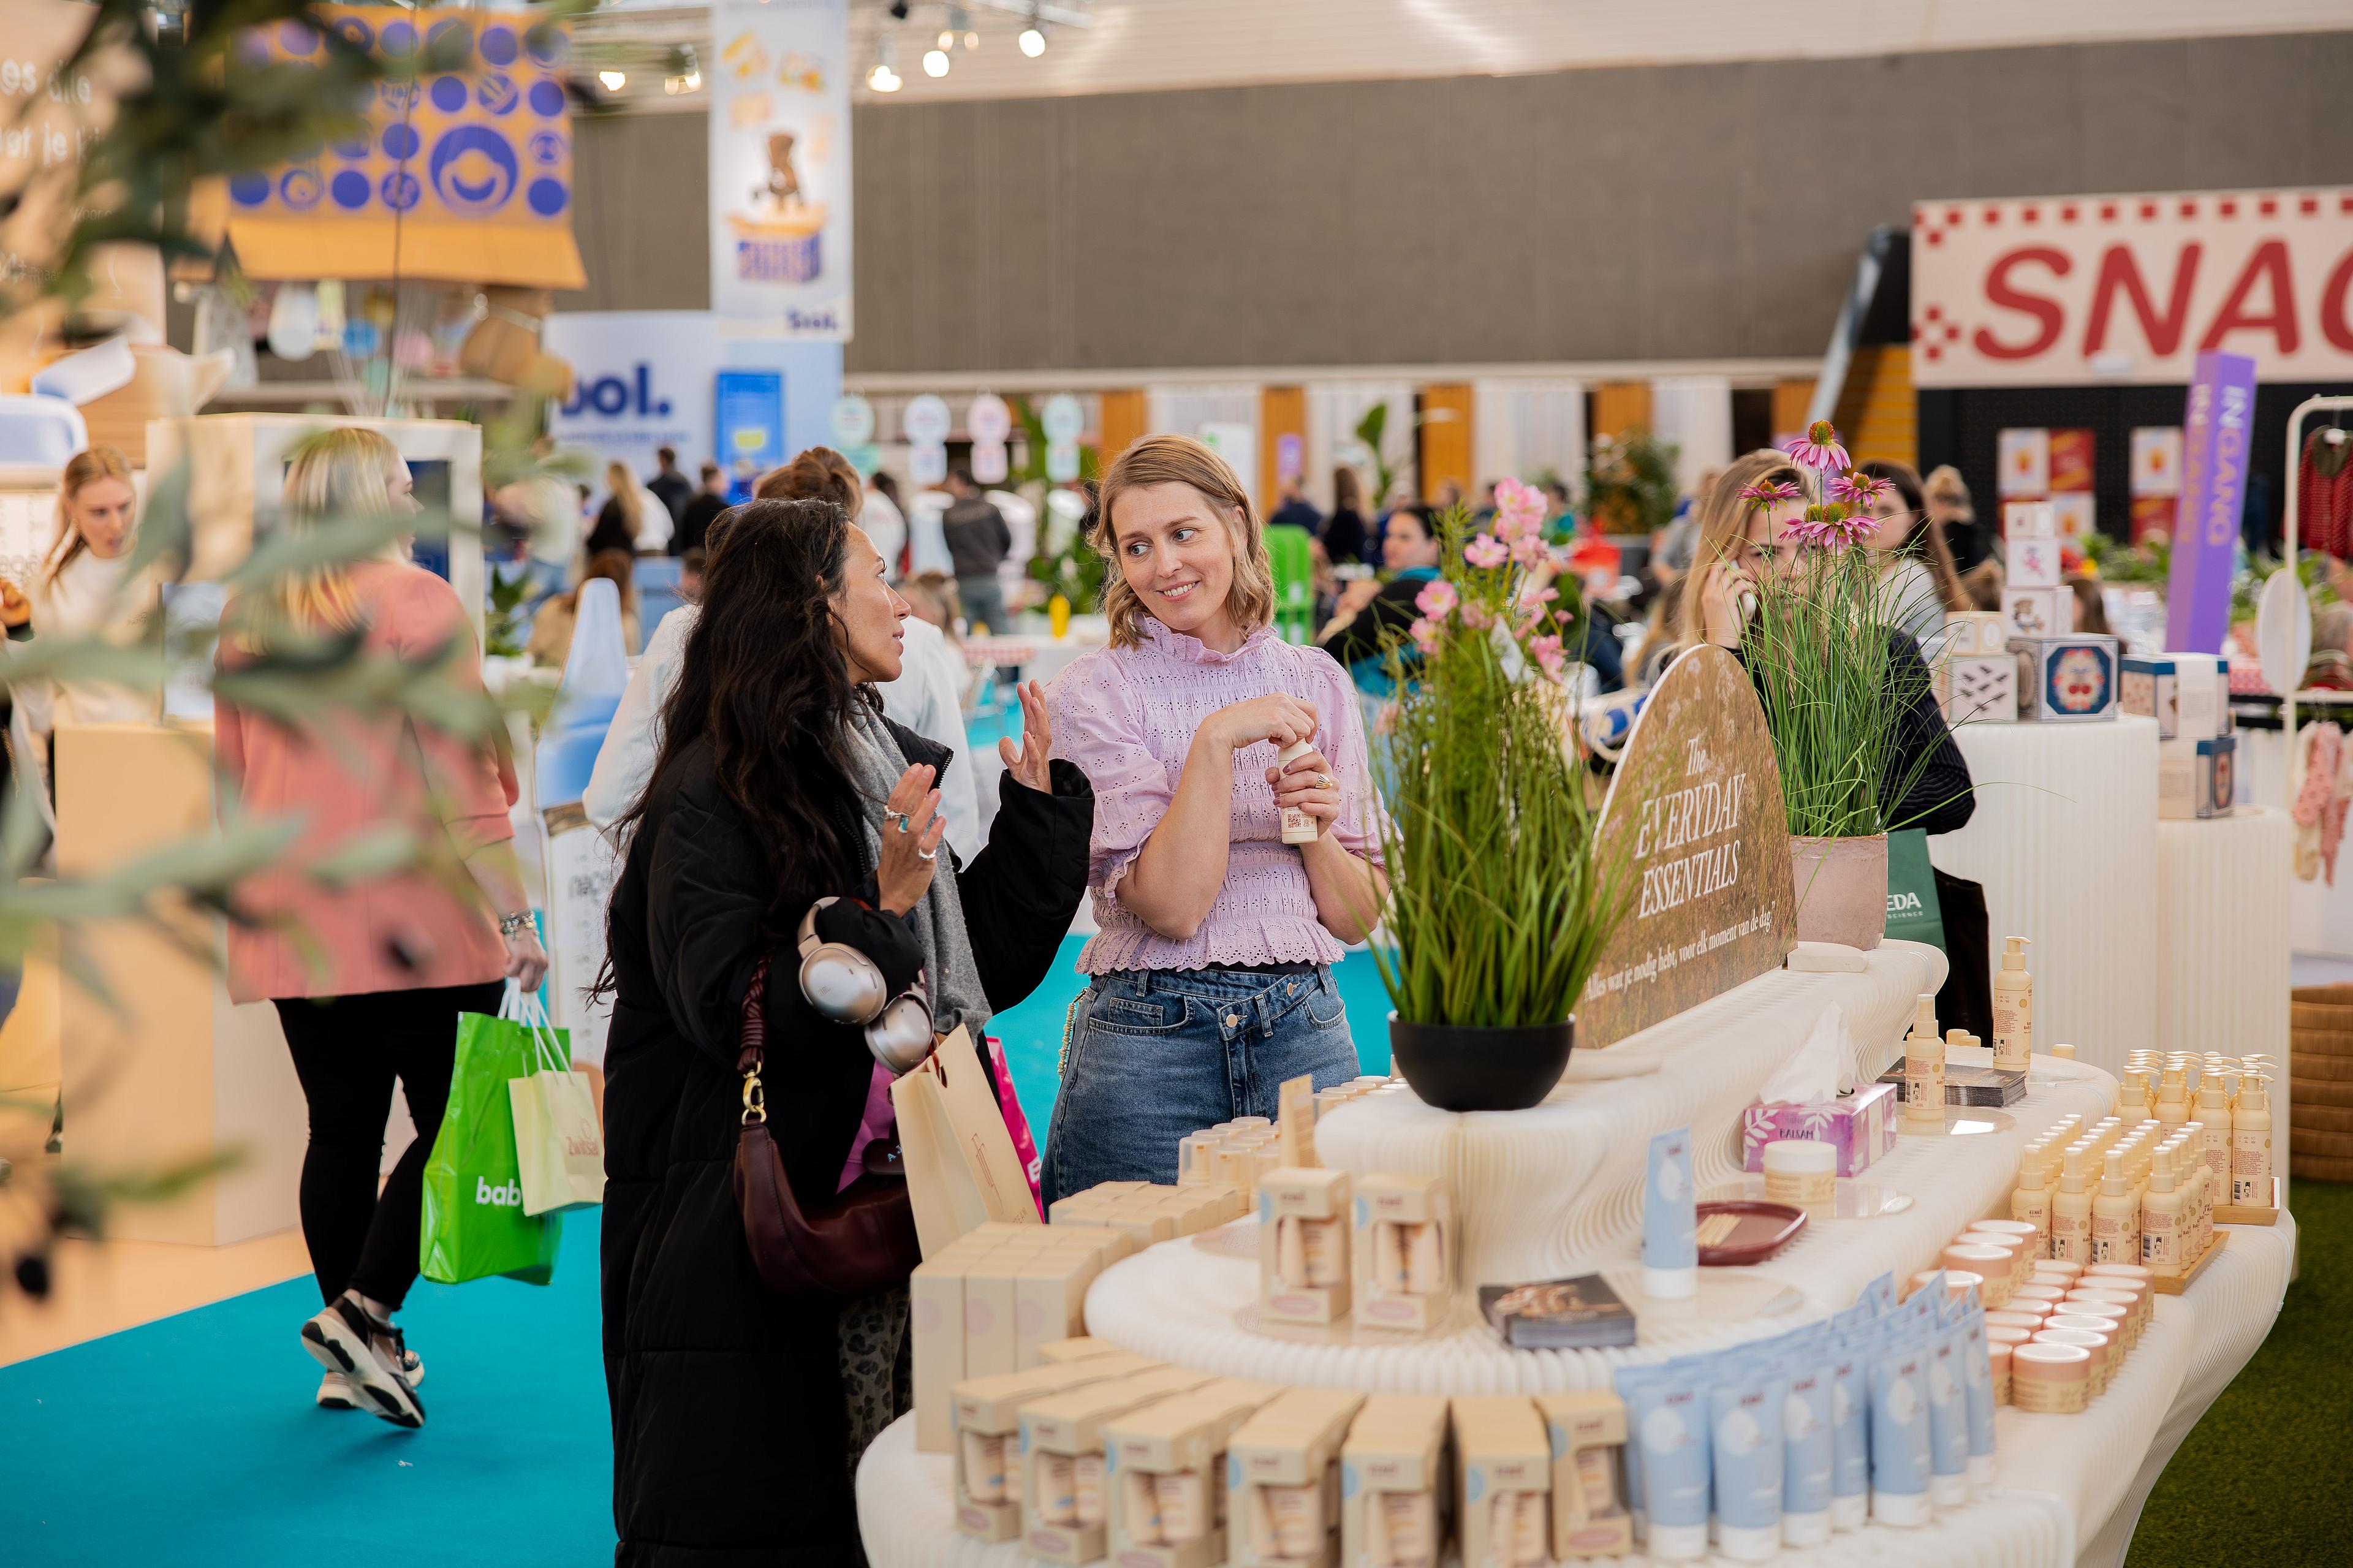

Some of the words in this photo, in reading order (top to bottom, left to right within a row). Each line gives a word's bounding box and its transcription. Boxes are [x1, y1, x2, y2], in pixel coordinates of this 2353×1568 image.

[2207, 384, 2247, 547] INGANG
[1686, 734, 1707, 776] The
[1634, 773, 1746, 859] EVERYDAY
[1637, 839, 1740, 919] ESSENTIALS
[1887, 892, 1922, 911] EDA
[1887, 911, 1924, 919] SCIENCE
[1607, 971, 1623, 991] wat
[1624, 963, 1633, 995] je
[1634, 950, 1657, 984] nodig
[1658, 943, 1677, 971] hebt,
[1679, 942, 1696, 963] voor
[1697, 929, 1708, 955] elk
[1709, 923, 1737, 950] moment
[1738, 919, 1749, 937] van
[1751, 907, 1759, 932] de
[1779, 1128, 1814, 1140] BALSAM
